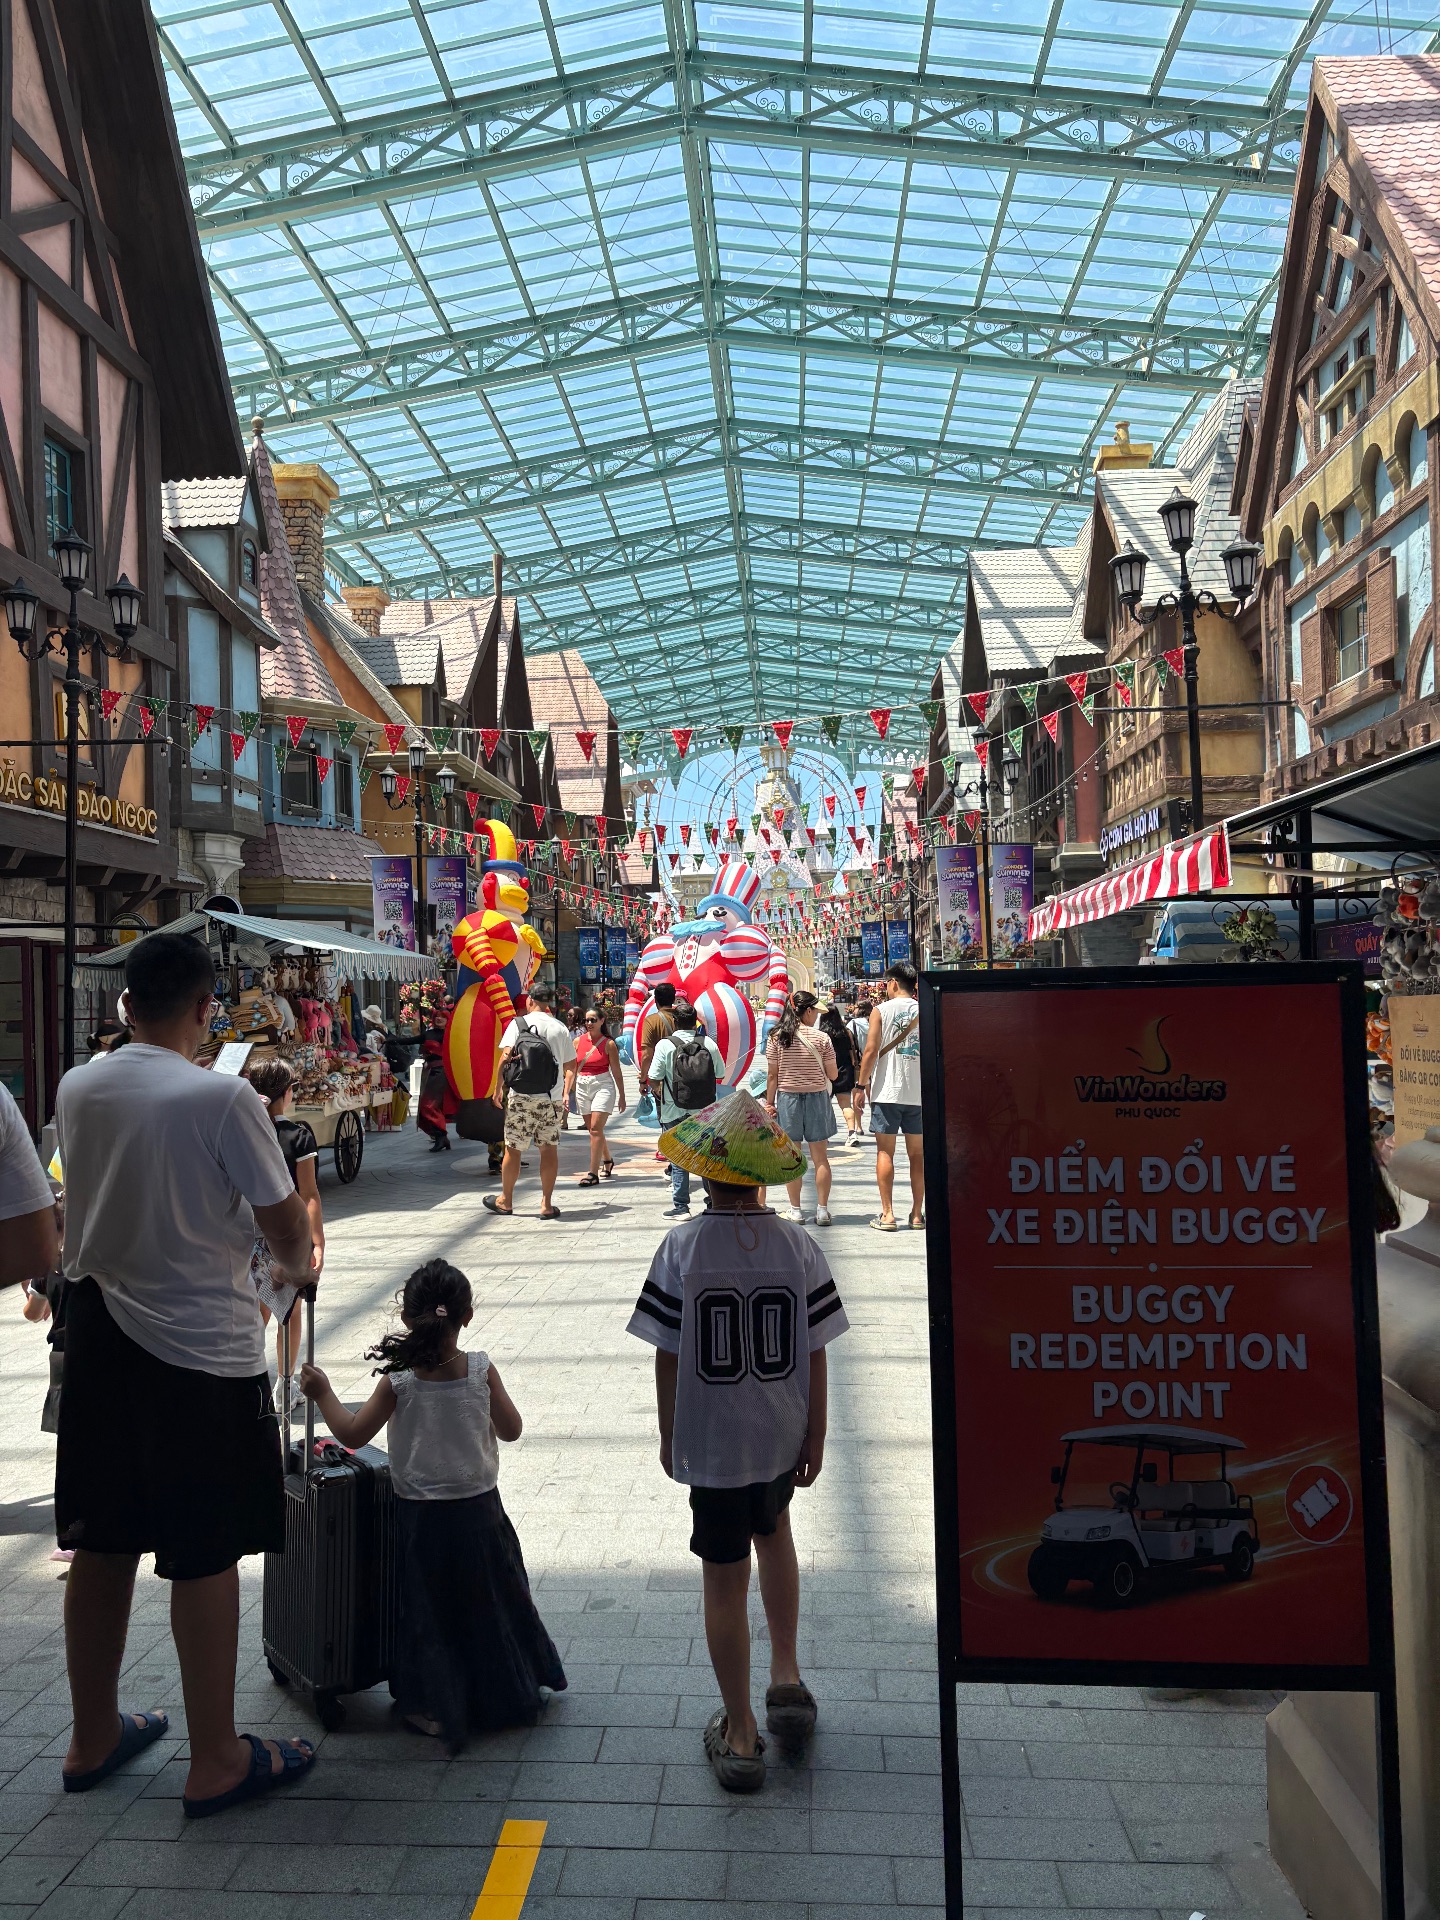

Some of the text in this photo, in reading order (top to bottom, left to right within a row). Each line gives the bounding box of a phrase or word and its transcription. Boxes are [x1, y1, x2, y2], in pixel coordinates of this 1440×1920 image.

[0, 758, 32, 804] ẶC
[78, 781, 112, 822] ĐẢO
[115, 800, 158, 836] NGỌC
[1108, 807, 1160, 851] CƠM GÀ HỘI AN
[376, 882, 410, 891] SUMMER
[430, 882, 464, 891] SUMMER
[941, 871, 975, 881] SUMMER
[996, 869, 1031, 878] SUMMER
[1412, 1045, 1421, 1062] VÉ
[1074, 1074, 1227, 1102] VinWonders
[1418, 1071, 1428, 1086] QR
[1428, 1072, 1440, 1087] CO
[1008, 1138, 1296, 1193] ĐIỂM ĐỔI VÉ
[986, 1199, 1327, 1255] XE ĐIỆN BUGGY
[1072, 1284, 1235, 1323] BUGGY
[694, 1285, 797, 1385] 00
[1009, 1333, 1308, 1371] REDEMPTION
[1092, 1381, 1230, 1419] POINT
